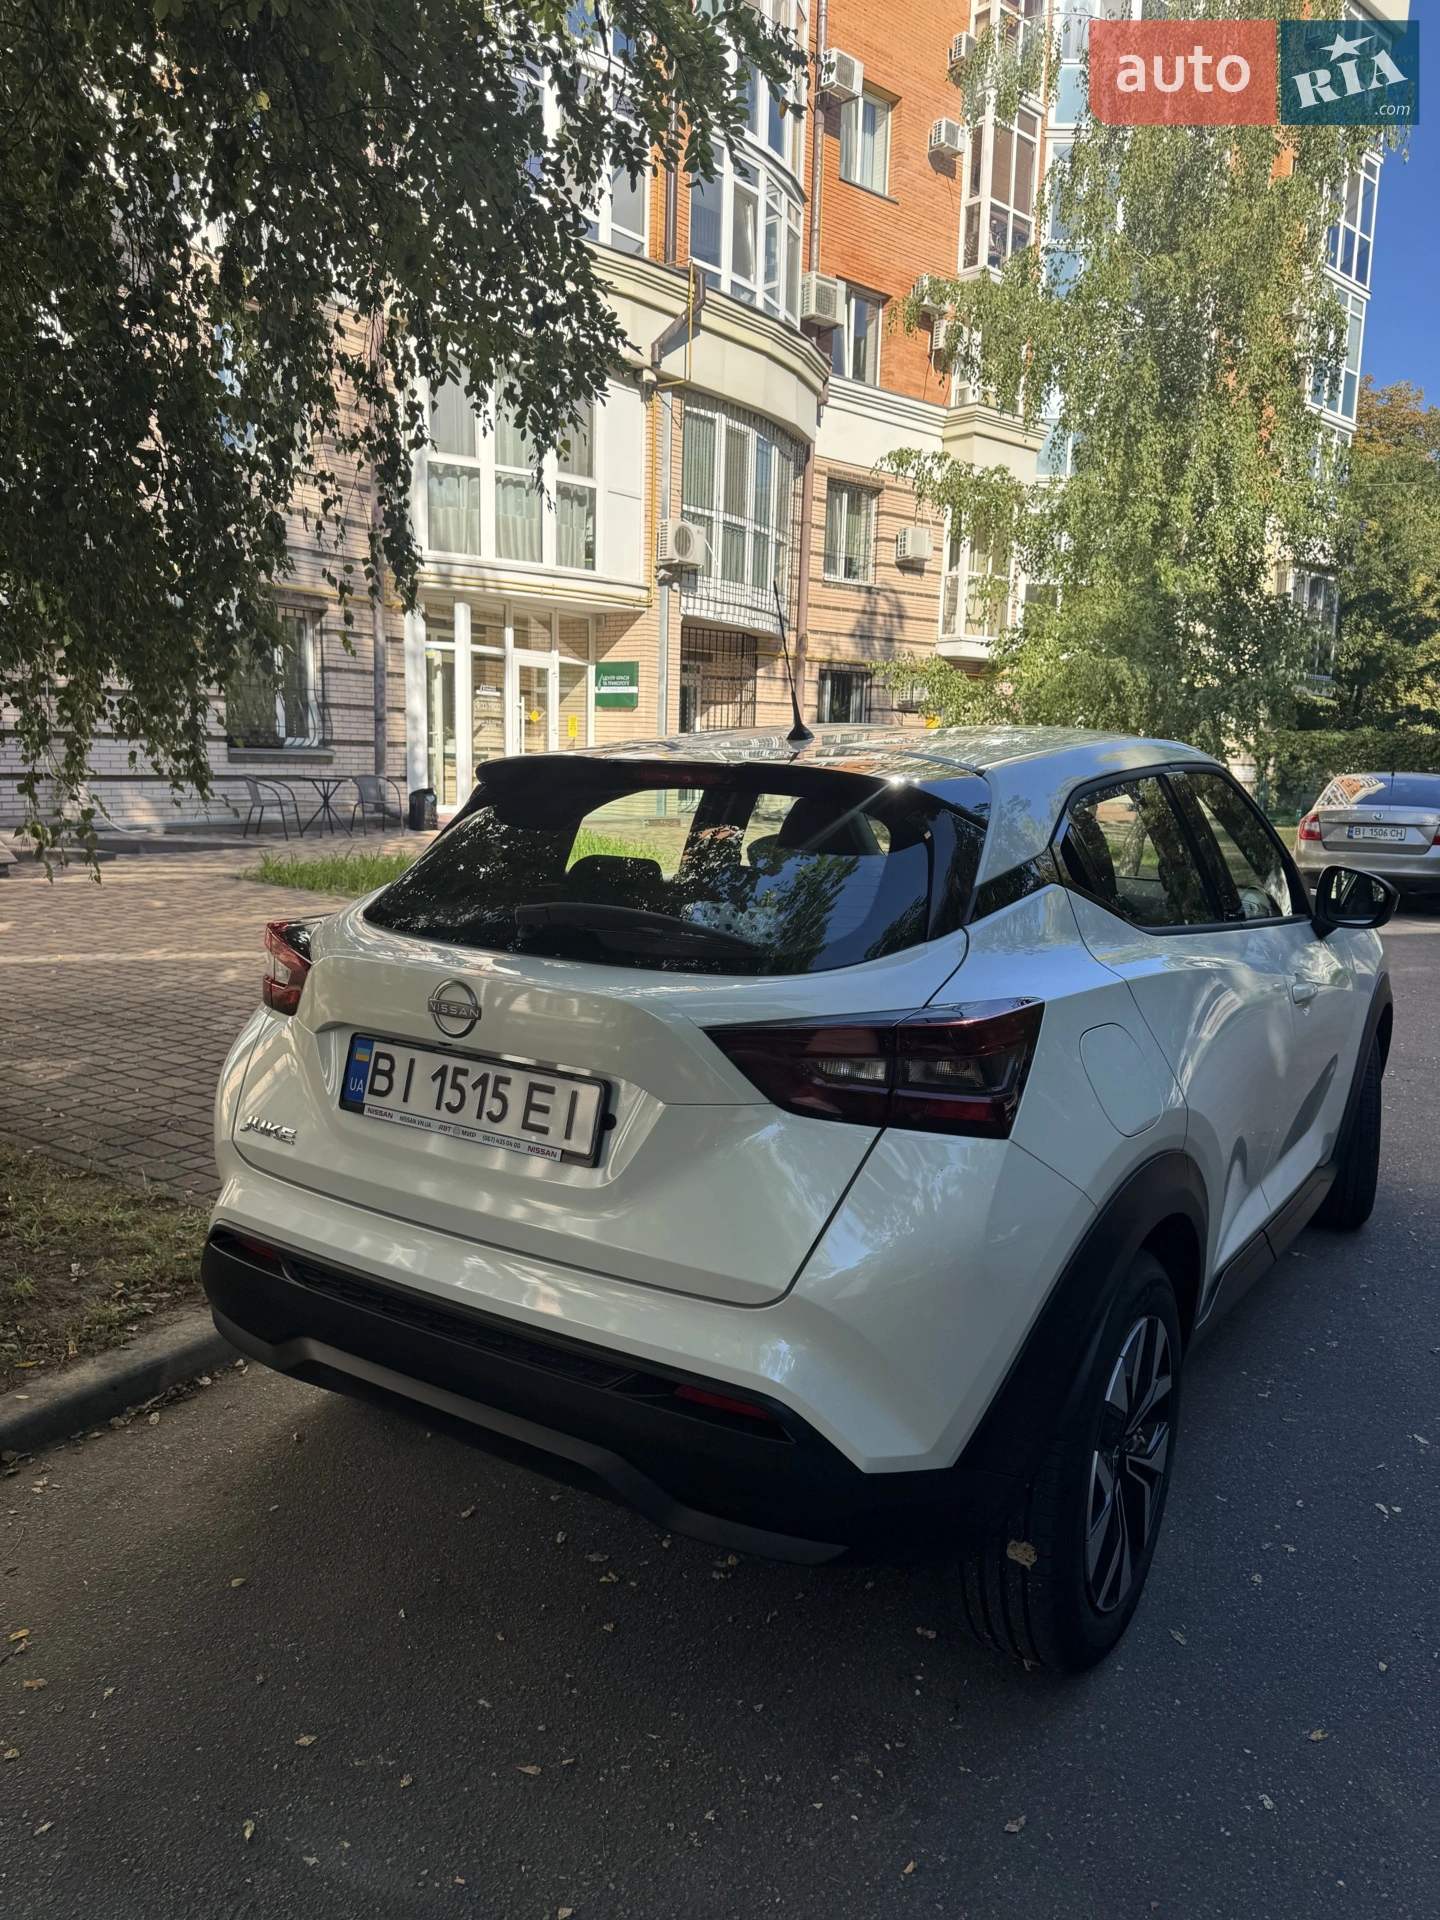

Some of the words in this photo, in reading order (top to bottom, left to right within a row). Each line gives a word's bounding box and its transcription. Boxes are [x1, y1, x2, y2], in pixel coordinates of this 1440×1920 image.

[1354, 828, 1366, 836] BI
[1369, 829, 1389, 837] 1506
[1390, 829, 1403, 838] CH
[429, 1001, 479, 1018] NISSAN
[349, 1076, 364, 1093] UA
[367, 1050, 416, 1103] BI
[430, 1064, 513, 1124] 1515
[521, 1081, 578, 1140] EI
[367, 1107, 394, 1119] NISSAN
[240, 1115, 298, 1146] JUKE
[527, 1145, 558, 1159] NISSAN
